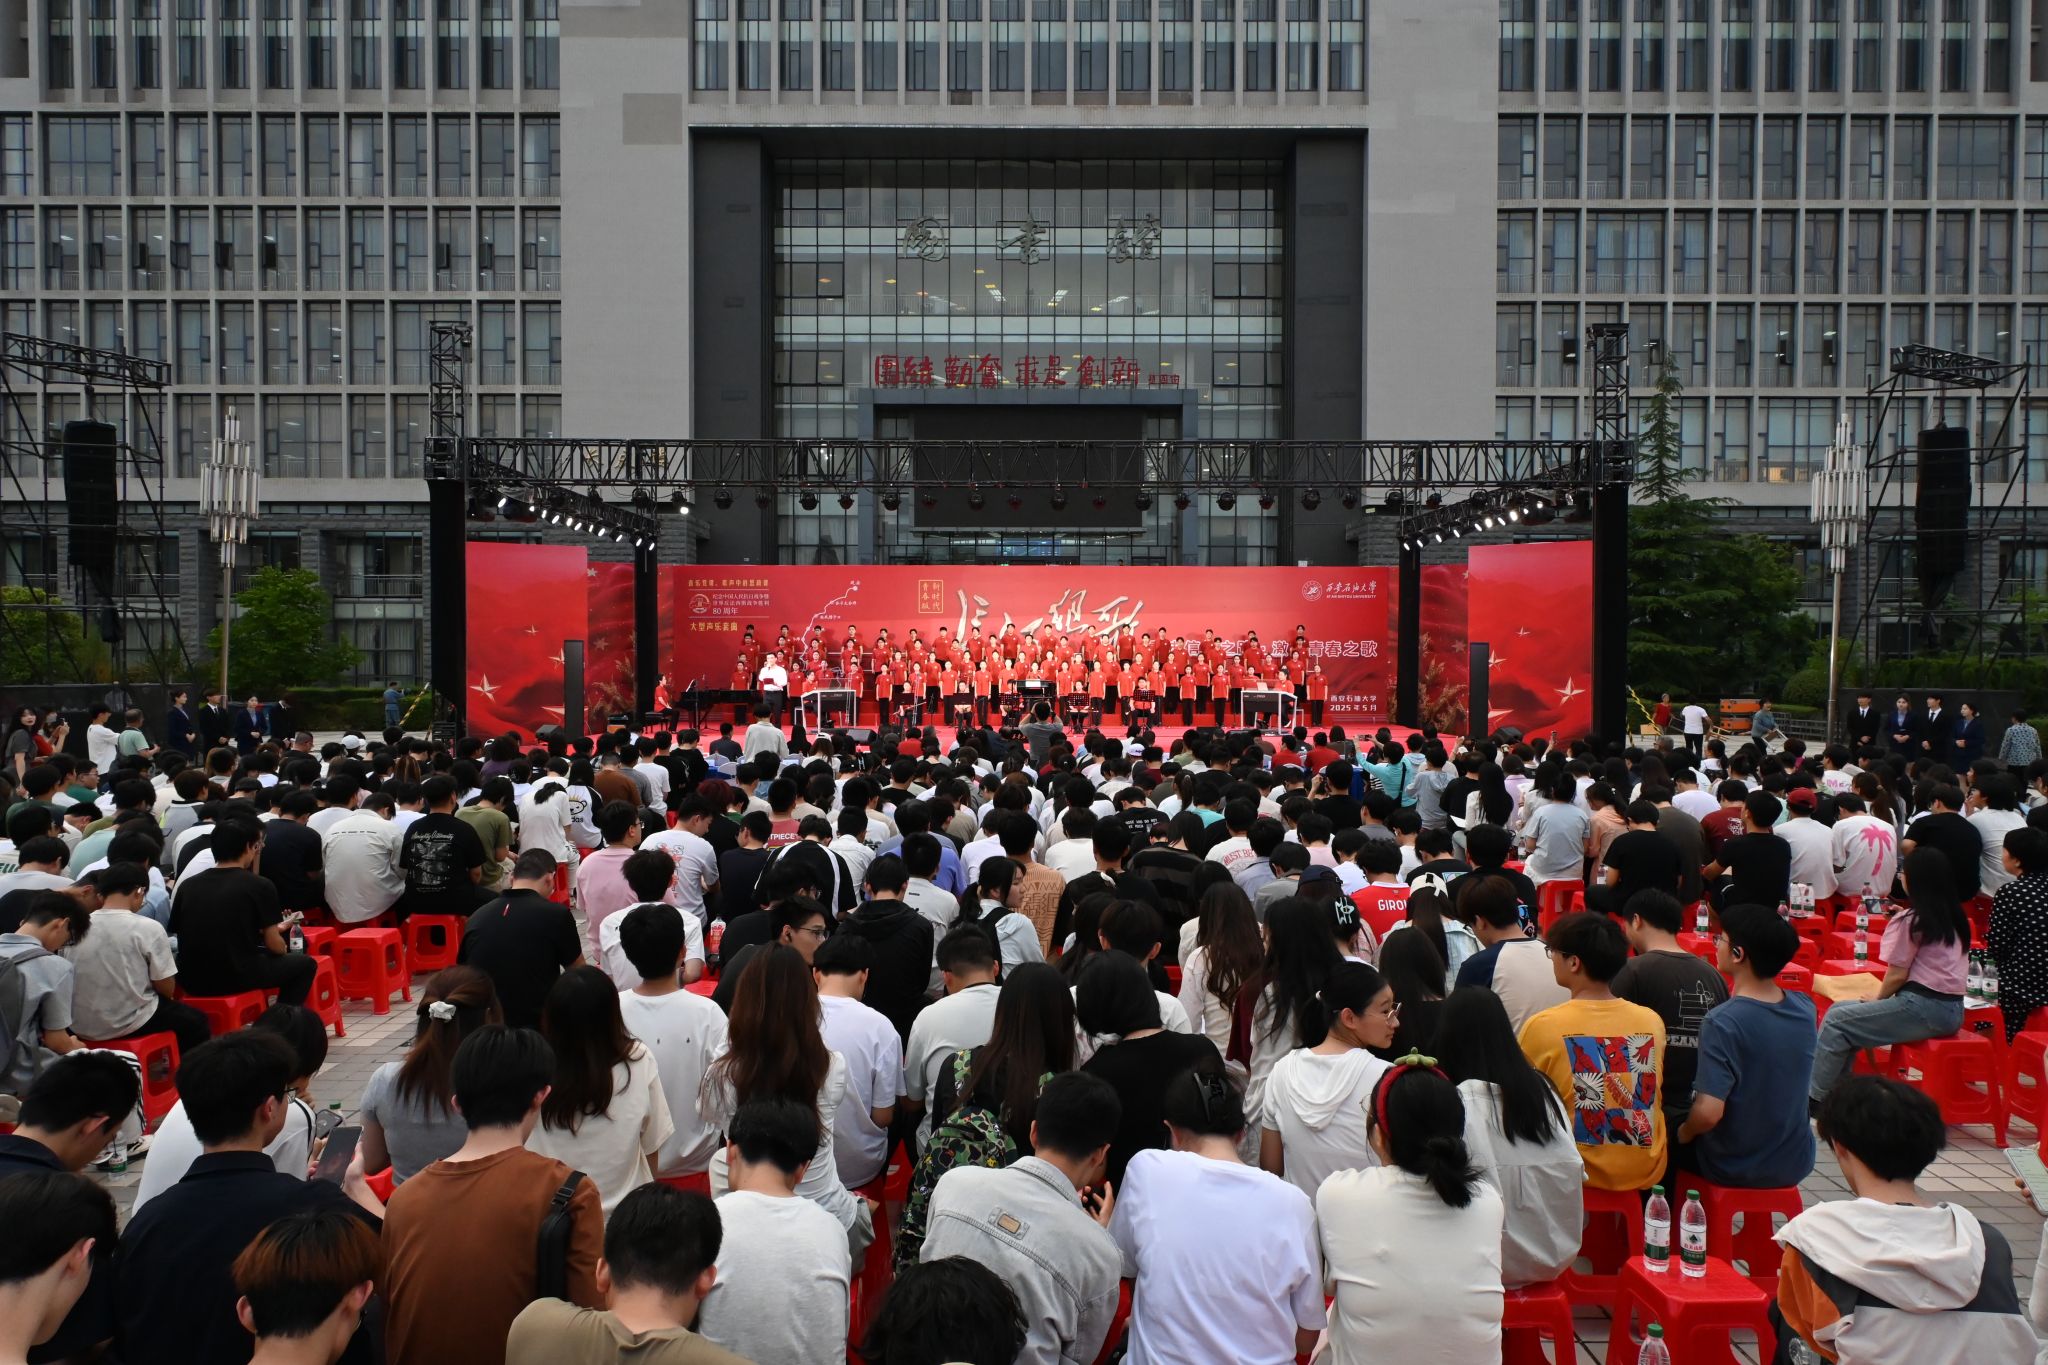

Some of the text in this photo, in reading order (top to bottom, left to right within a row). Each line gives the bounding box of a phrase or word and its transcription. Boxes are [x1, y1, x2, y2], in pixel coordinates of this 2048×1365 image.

[690, 622, 738, 631] 大型声乐套曲
[1223, 849, 1241, 866] MUST
